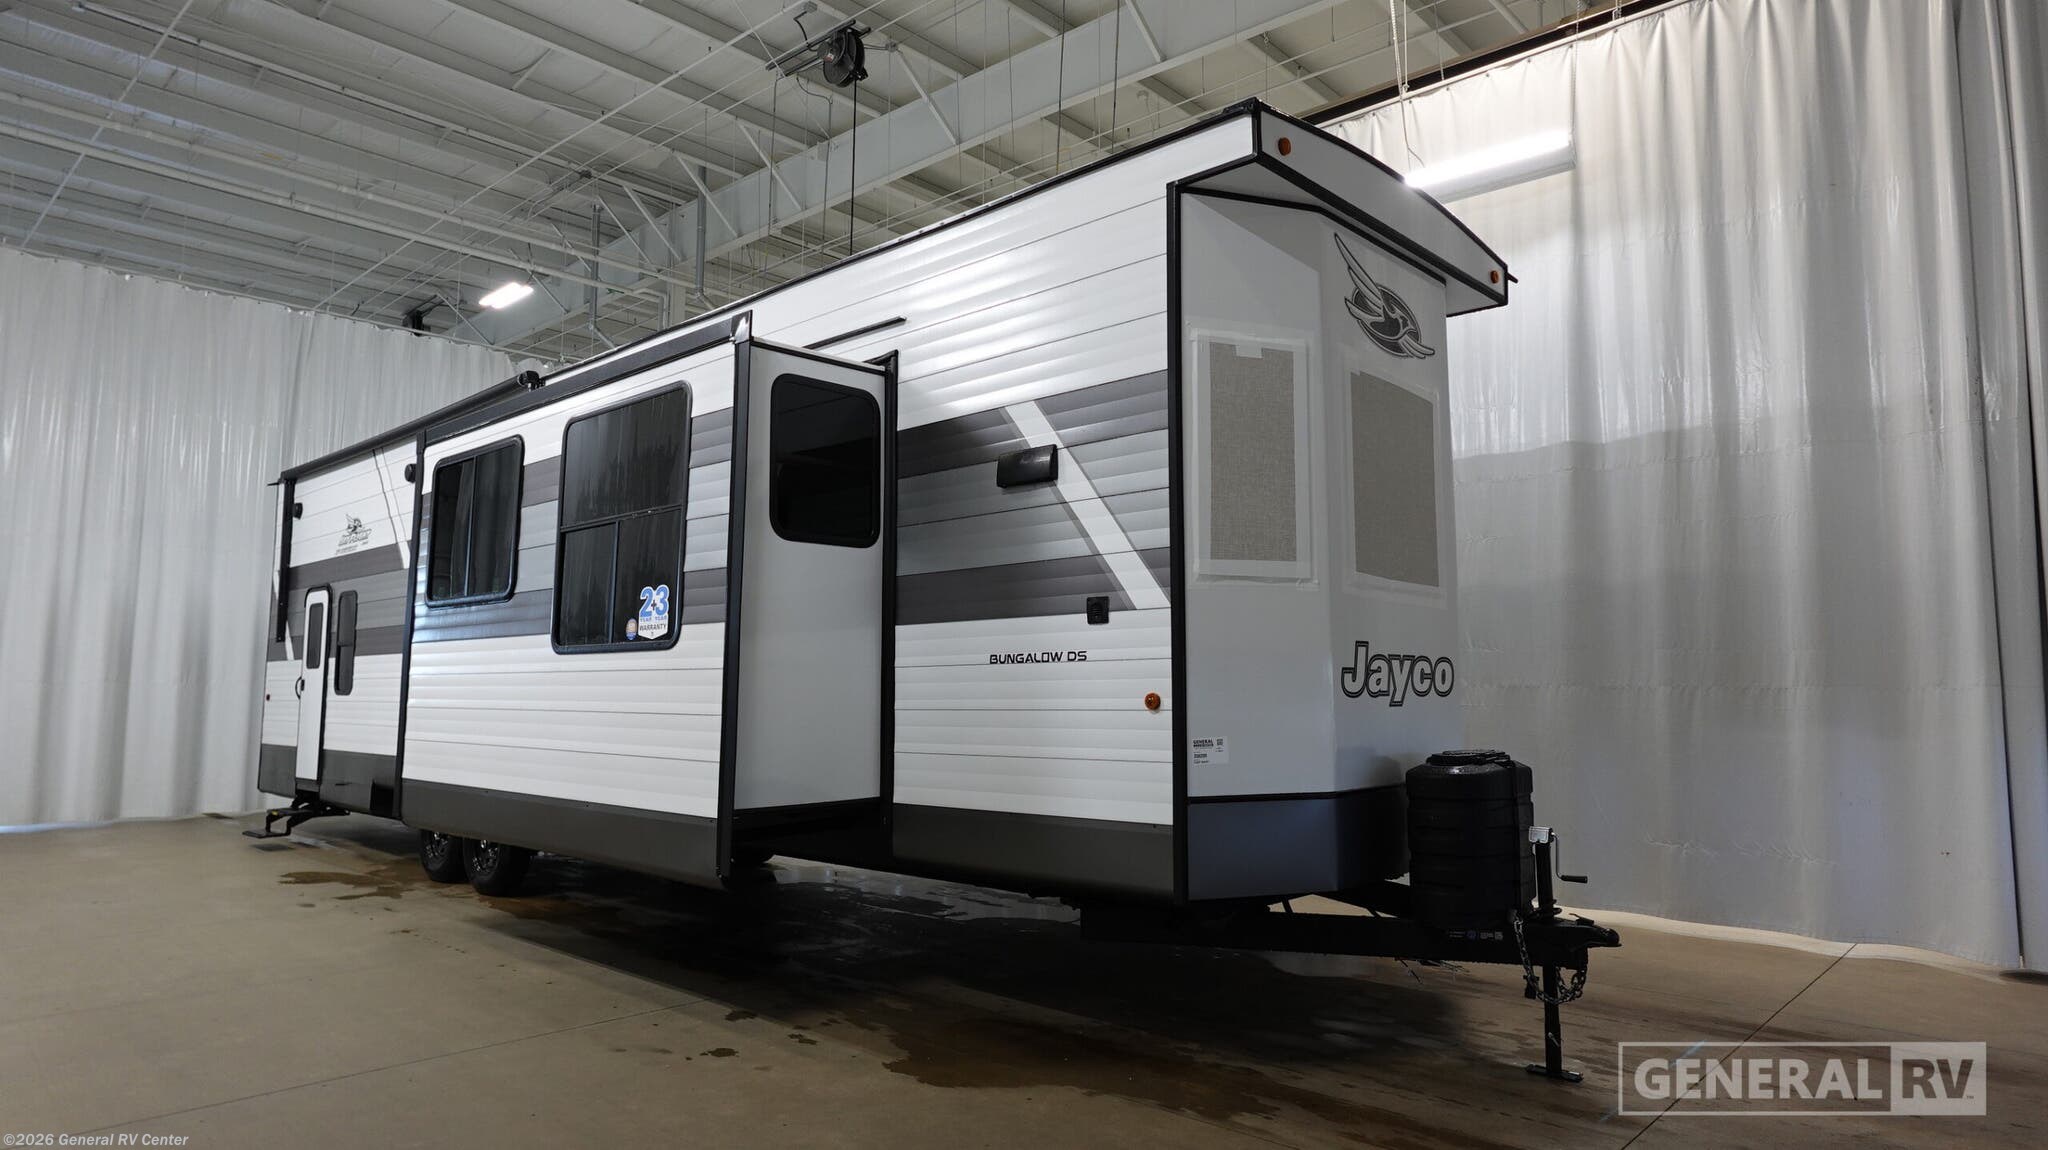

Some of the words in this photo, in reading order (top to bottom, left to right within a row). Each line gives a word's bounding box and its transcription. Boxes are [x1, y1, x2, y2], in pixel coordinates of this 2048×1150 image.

[639, 623, 667, 632] WARRANTY
[989, 652, 1063, 664] BUNGALOW
[1067, 650, 1087, 662] DS
[1341, 640, 1454, 707] Jayco
